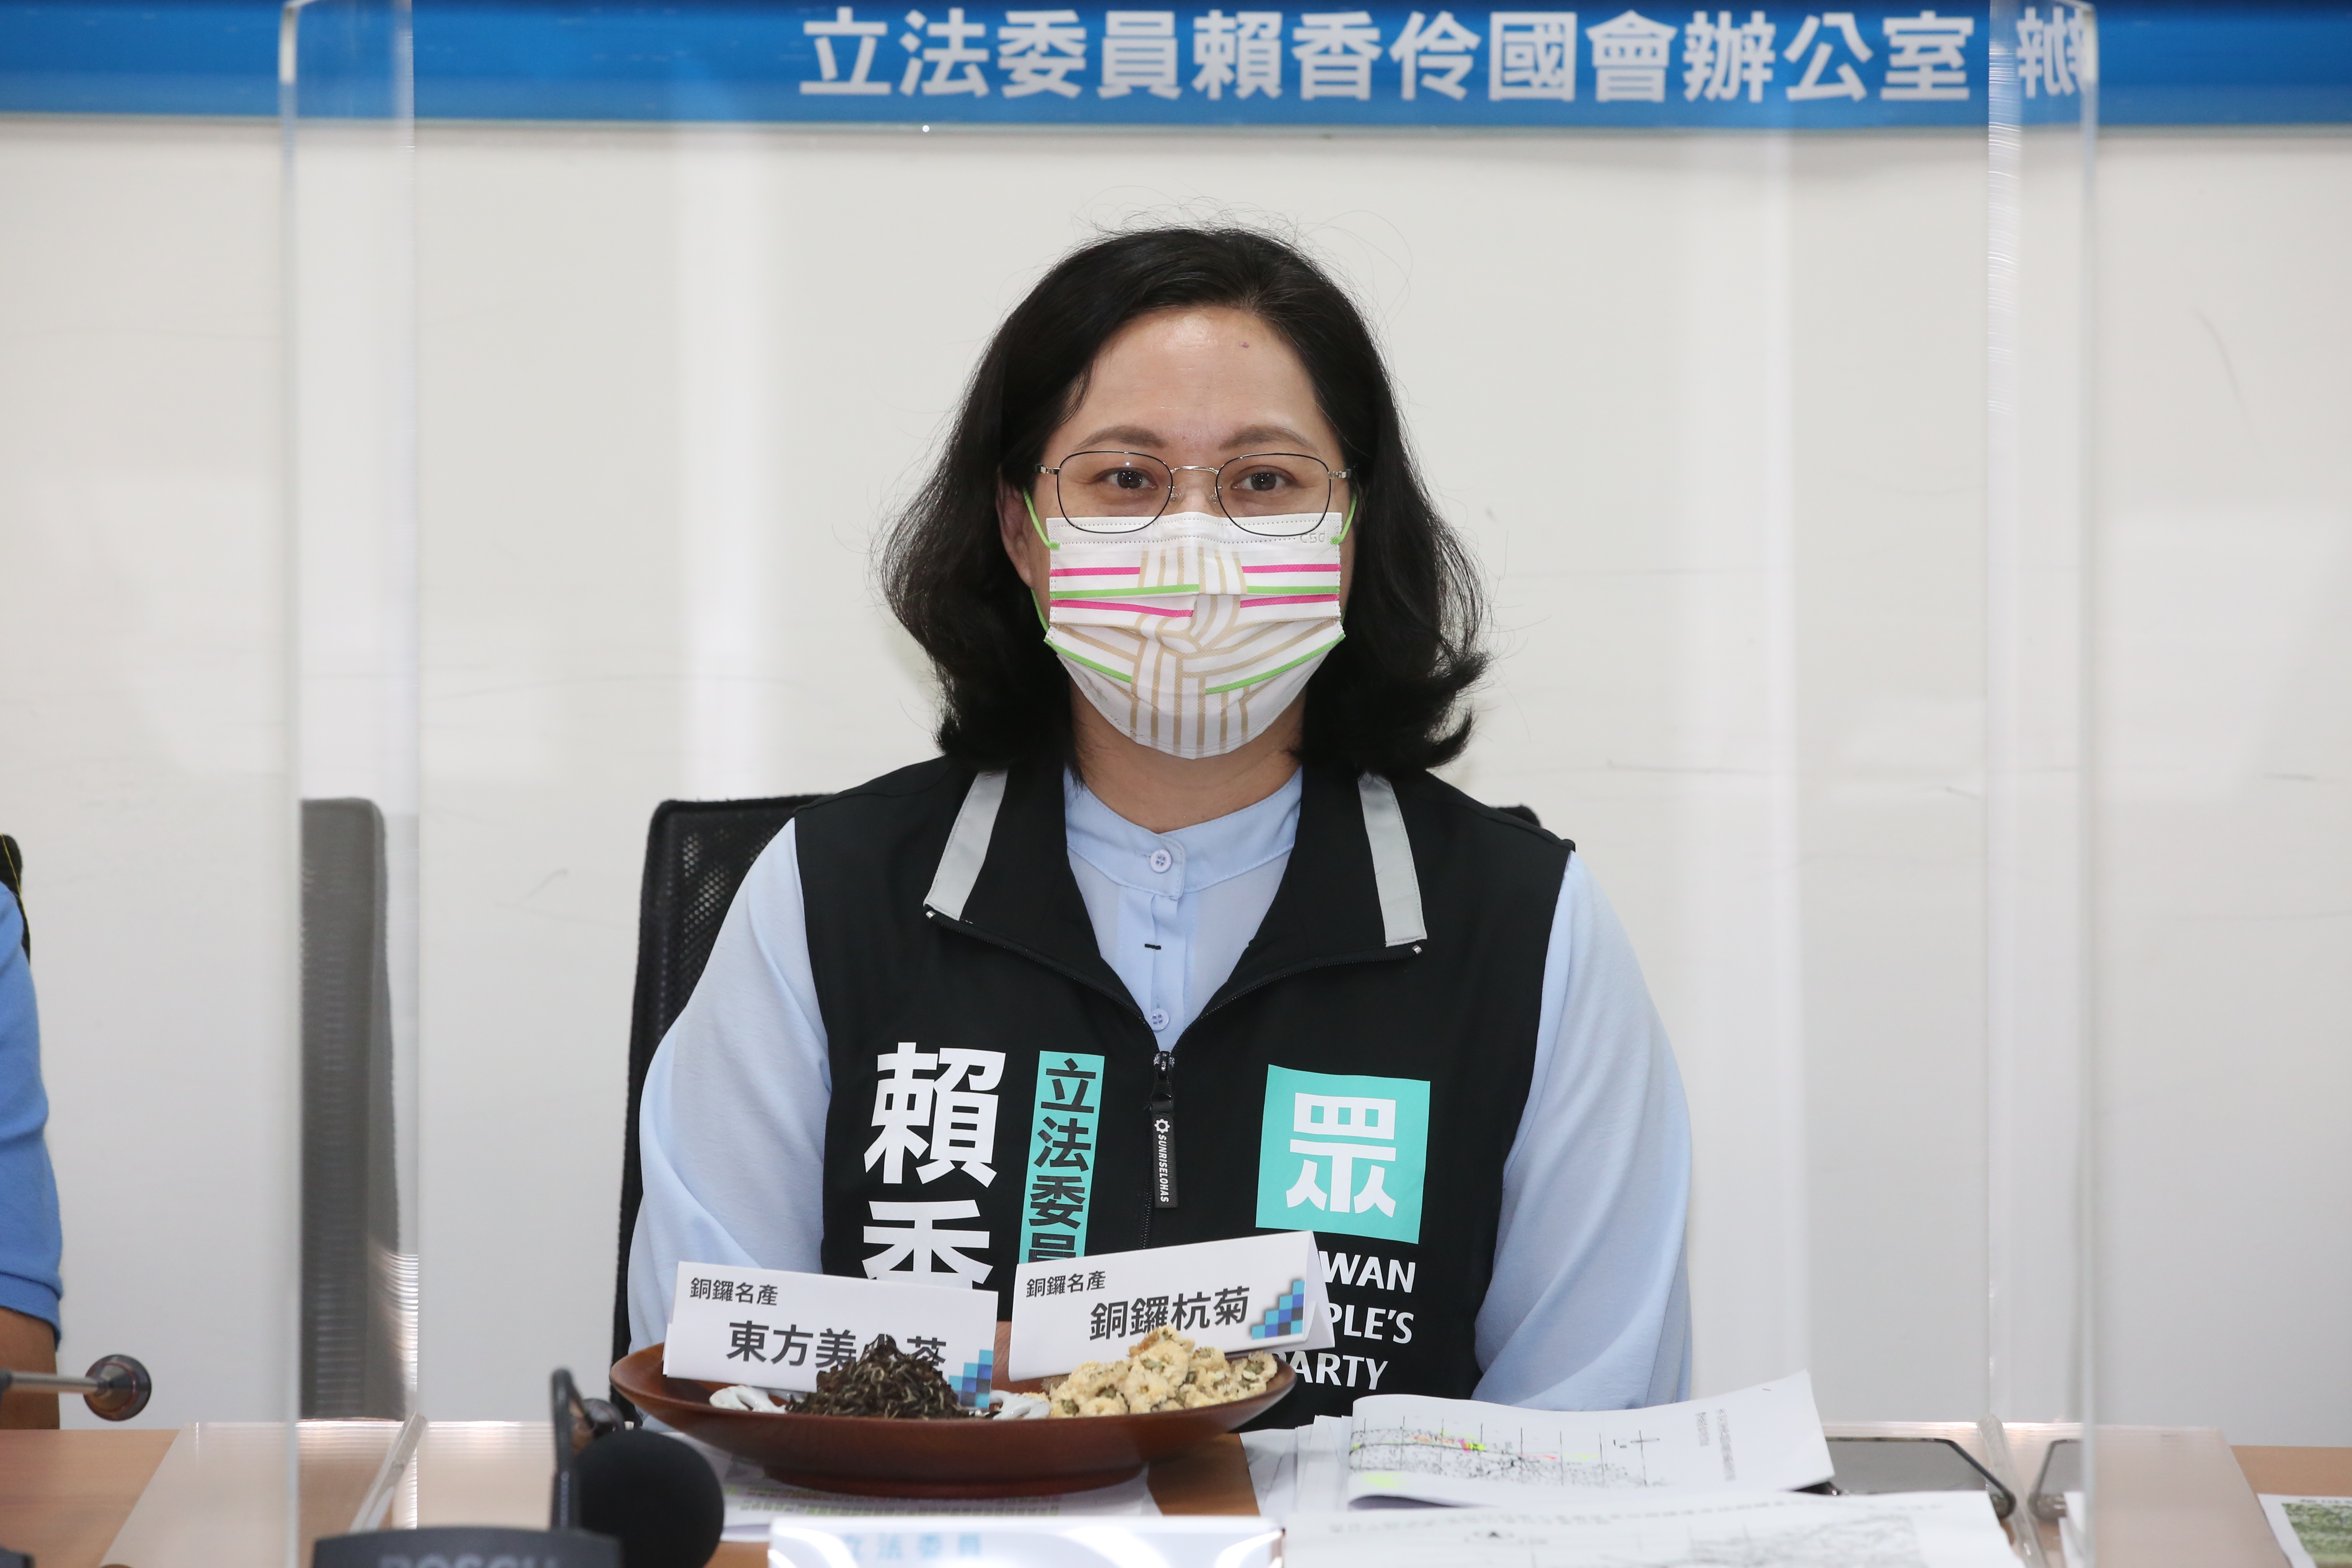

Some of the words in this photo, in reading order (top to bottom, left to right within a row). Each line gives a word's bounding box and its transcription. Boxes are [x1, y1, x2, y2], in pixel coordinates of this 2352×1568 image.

[799, 6, 1975, 102] 立法委員賴香伶國會辦公室
[1158, 1134, 1169, 1203] SUNRISELOHAS
[689, 1277, 778, 1306] 銅鑼名產
[1026, 1270, 1106, 1298] 銅鑼名產
[1089, 1285, 1250, 1341] 銅鑼杭菊
[726, 1320, 947, 1372] 東方美茶
[1272, 1350, 1388, 1390] ARTY
